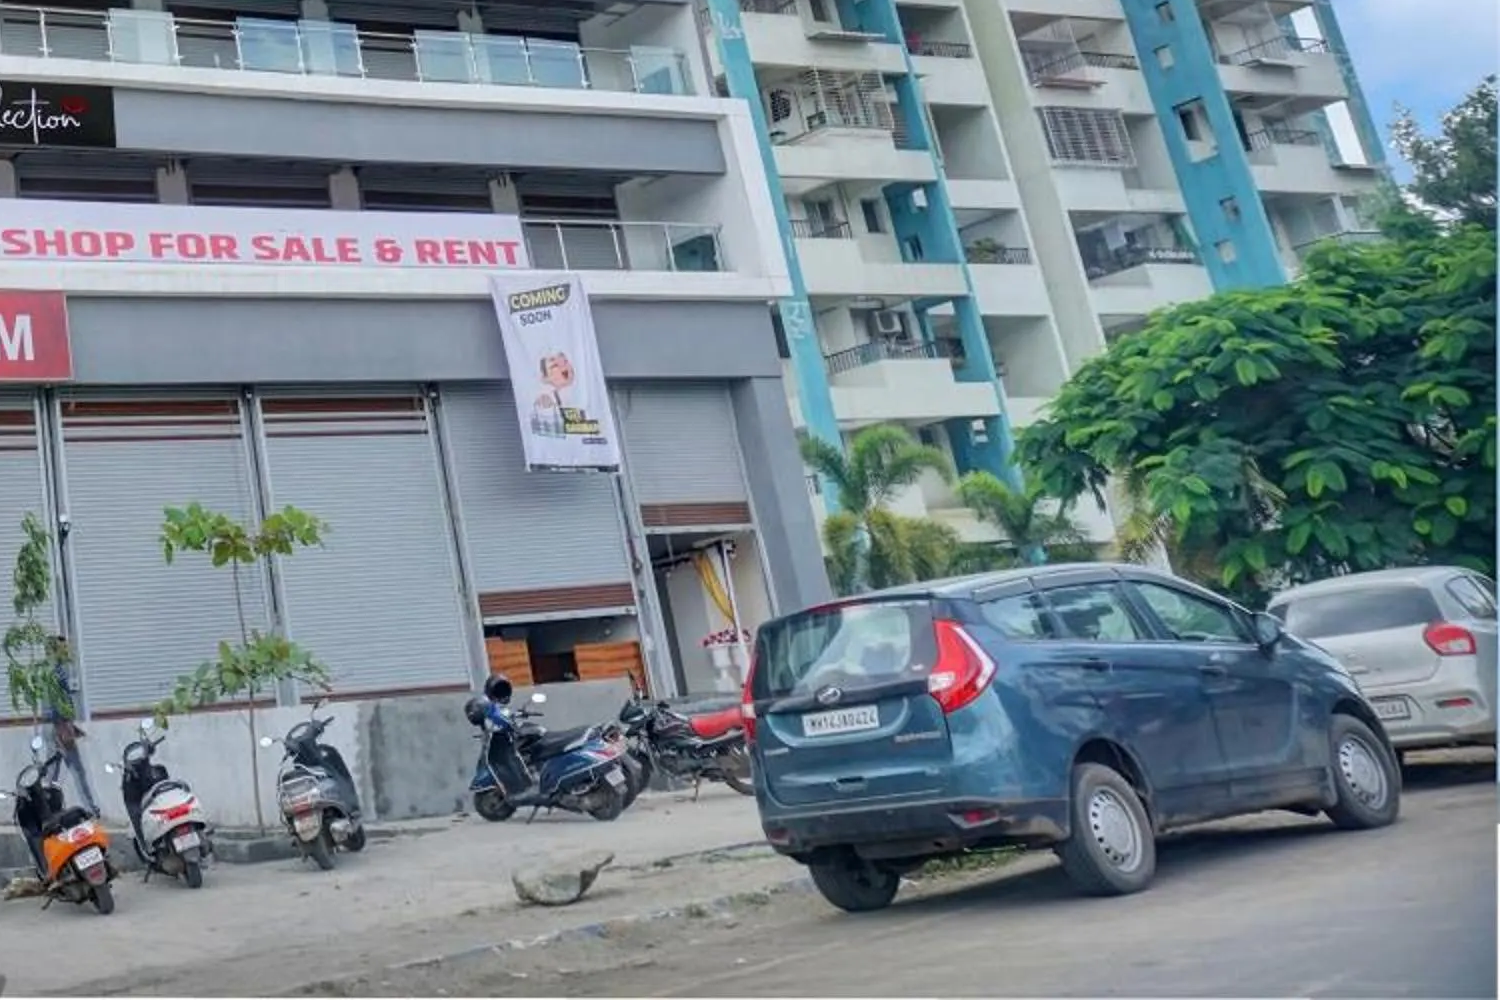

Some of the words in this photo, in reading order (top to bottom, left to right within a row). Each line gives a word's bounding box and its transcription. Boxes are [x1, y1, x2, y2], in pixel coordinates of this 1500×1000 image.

[1, 229, 134, 257] SHOP
[149, 232, 240, 260] FOR
[251, 235, 362, 263] SALE
[374, 238, 404, 263] &
[415, 239, 519, 265] RENT
[510, 286, 566, 310] COMING
[519, 310, 552, 327] SOON
